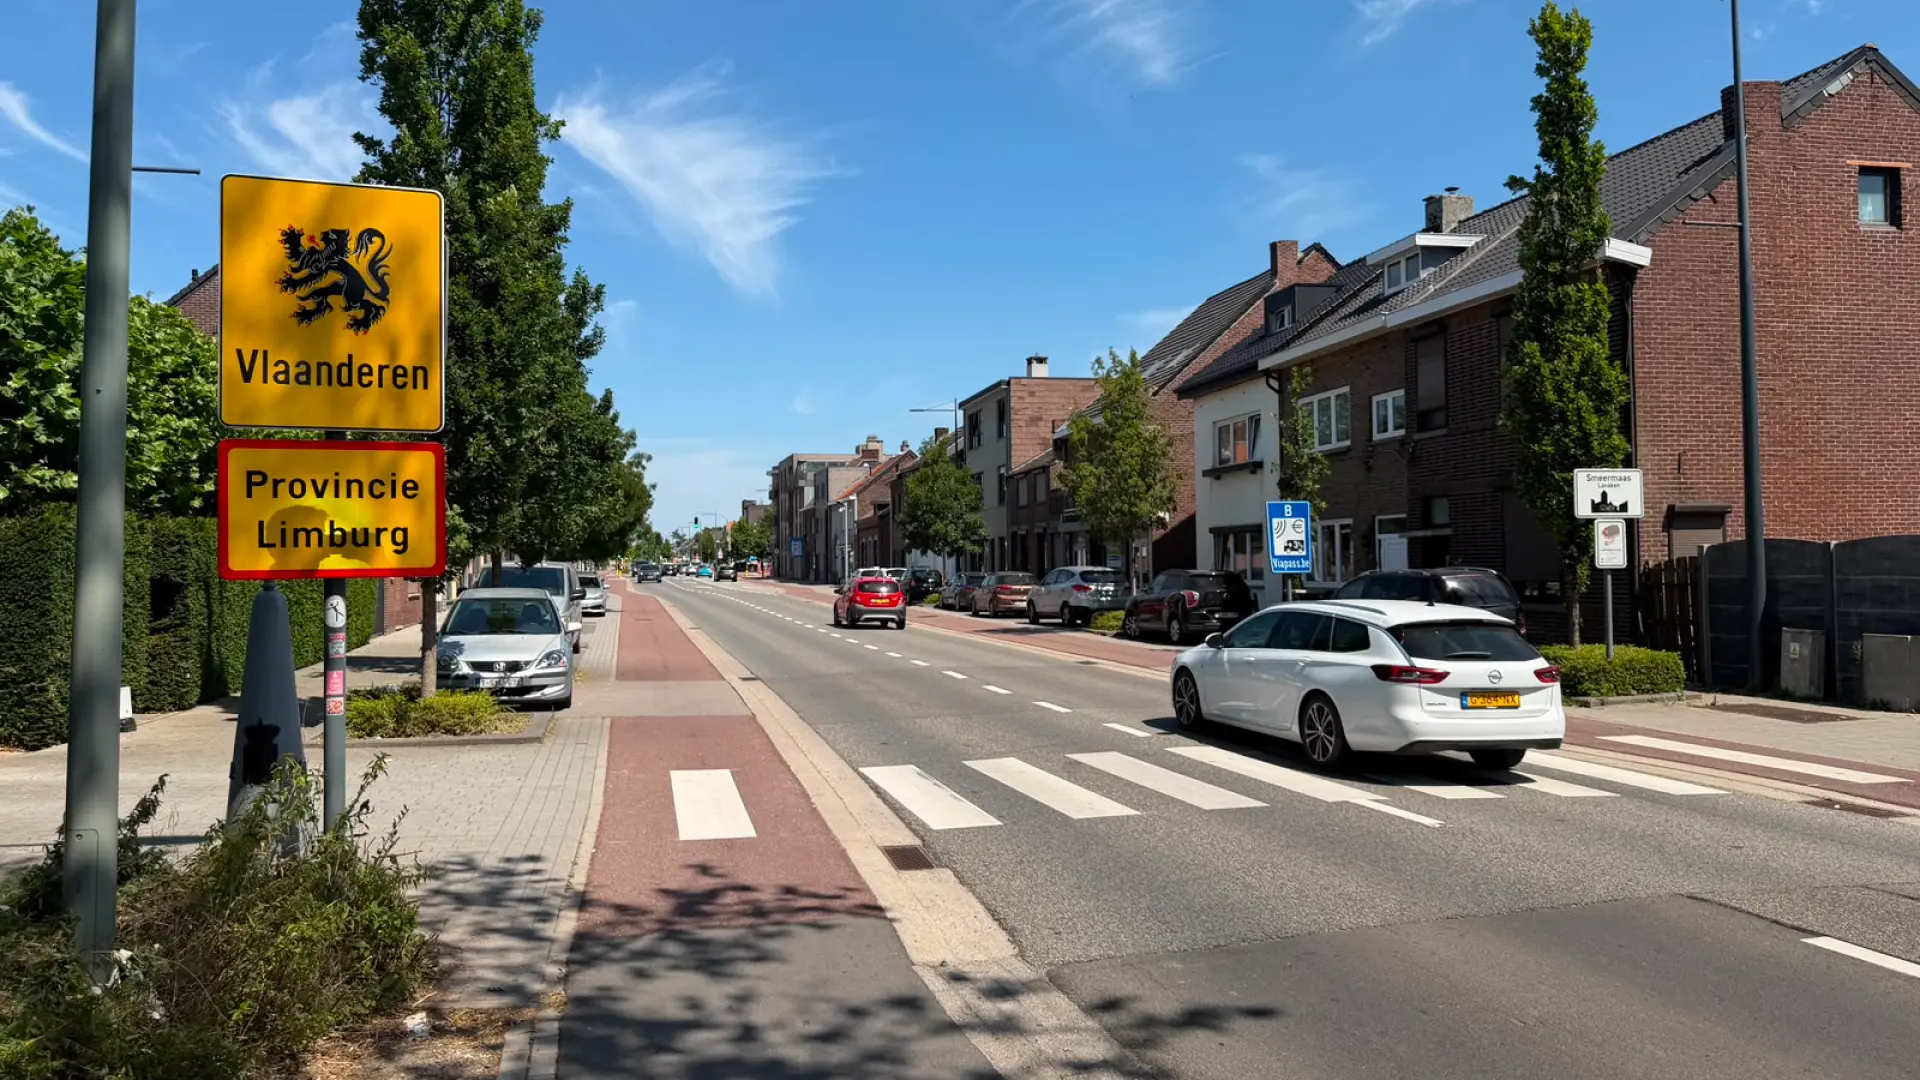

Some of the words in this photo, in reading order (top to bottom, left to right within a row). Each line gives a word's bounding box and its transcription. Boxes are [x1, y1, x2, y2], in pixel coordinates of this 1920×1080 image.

[235, 347, 429, 390] Vlaanderen
[245, 469, 420, 500] Provincie
[1585, 473, 1632, 482] Smeermaas
[1284, 503, 1293, 517] B
[257, 519, 409, 555] Limburg
[1272, 557, 1310, 571] Viapass.be
